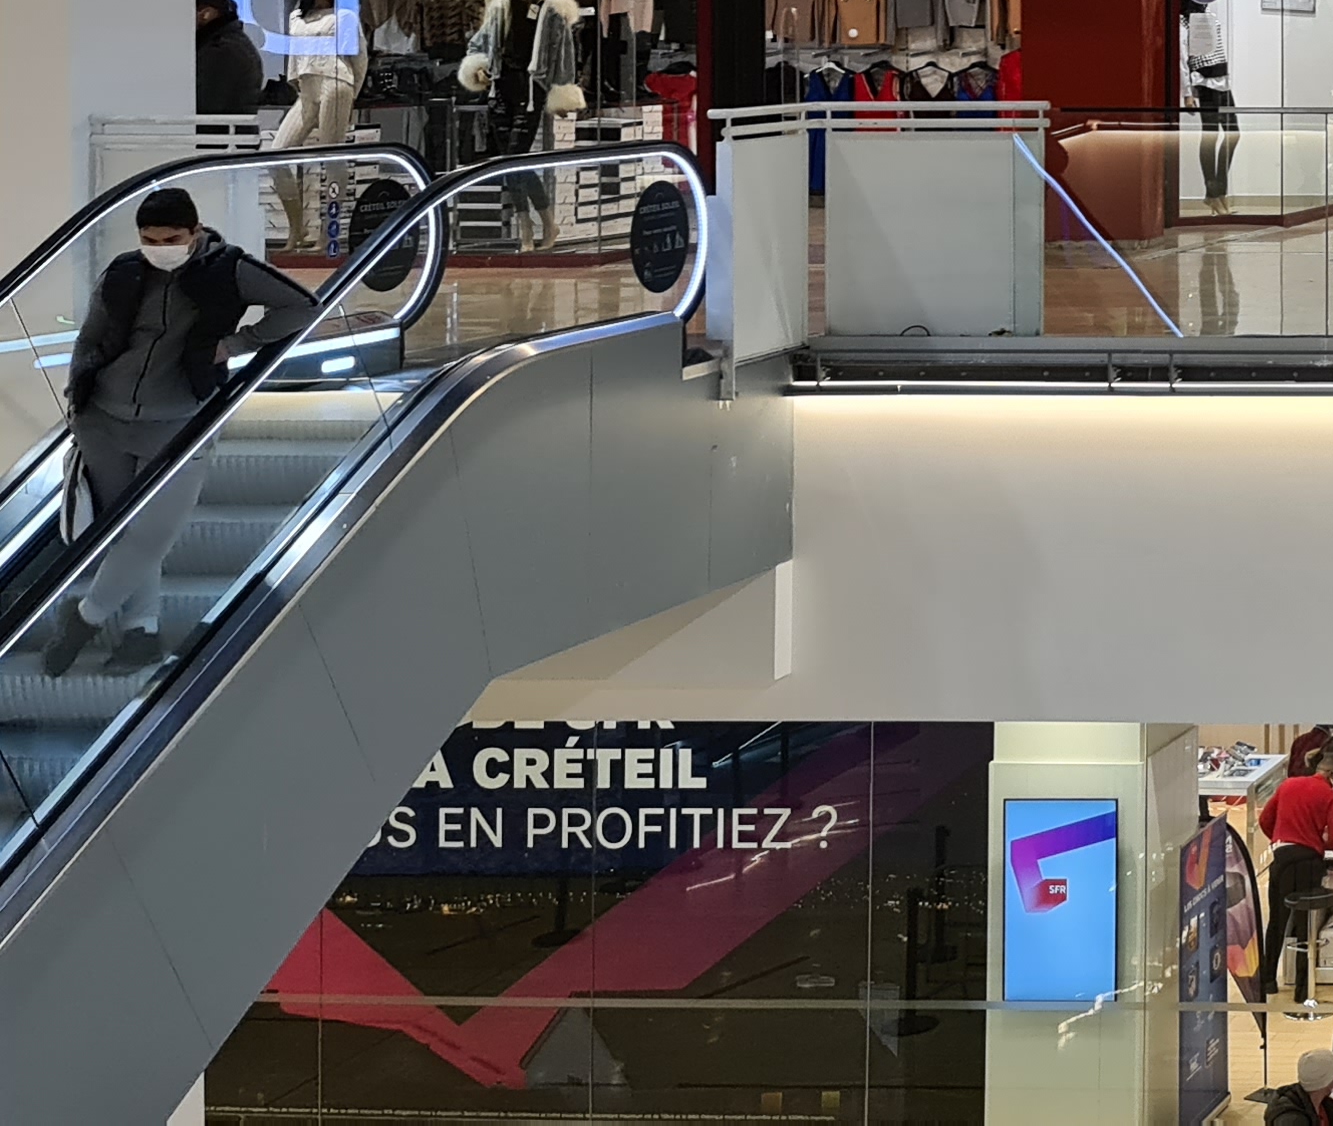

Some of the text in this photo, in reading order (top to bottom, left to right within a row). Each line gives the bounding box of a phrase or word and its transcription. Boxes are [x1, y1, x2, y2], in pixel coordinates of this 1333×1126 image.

[472, 738, 707, 789] CRÉTEIL
[438, 807, 503, 848] EN
[527, 807, 793, 850] PROFITIEZ
[811, 805, 838, 849] ?
[1049, 884, 1067, 894] SFR
